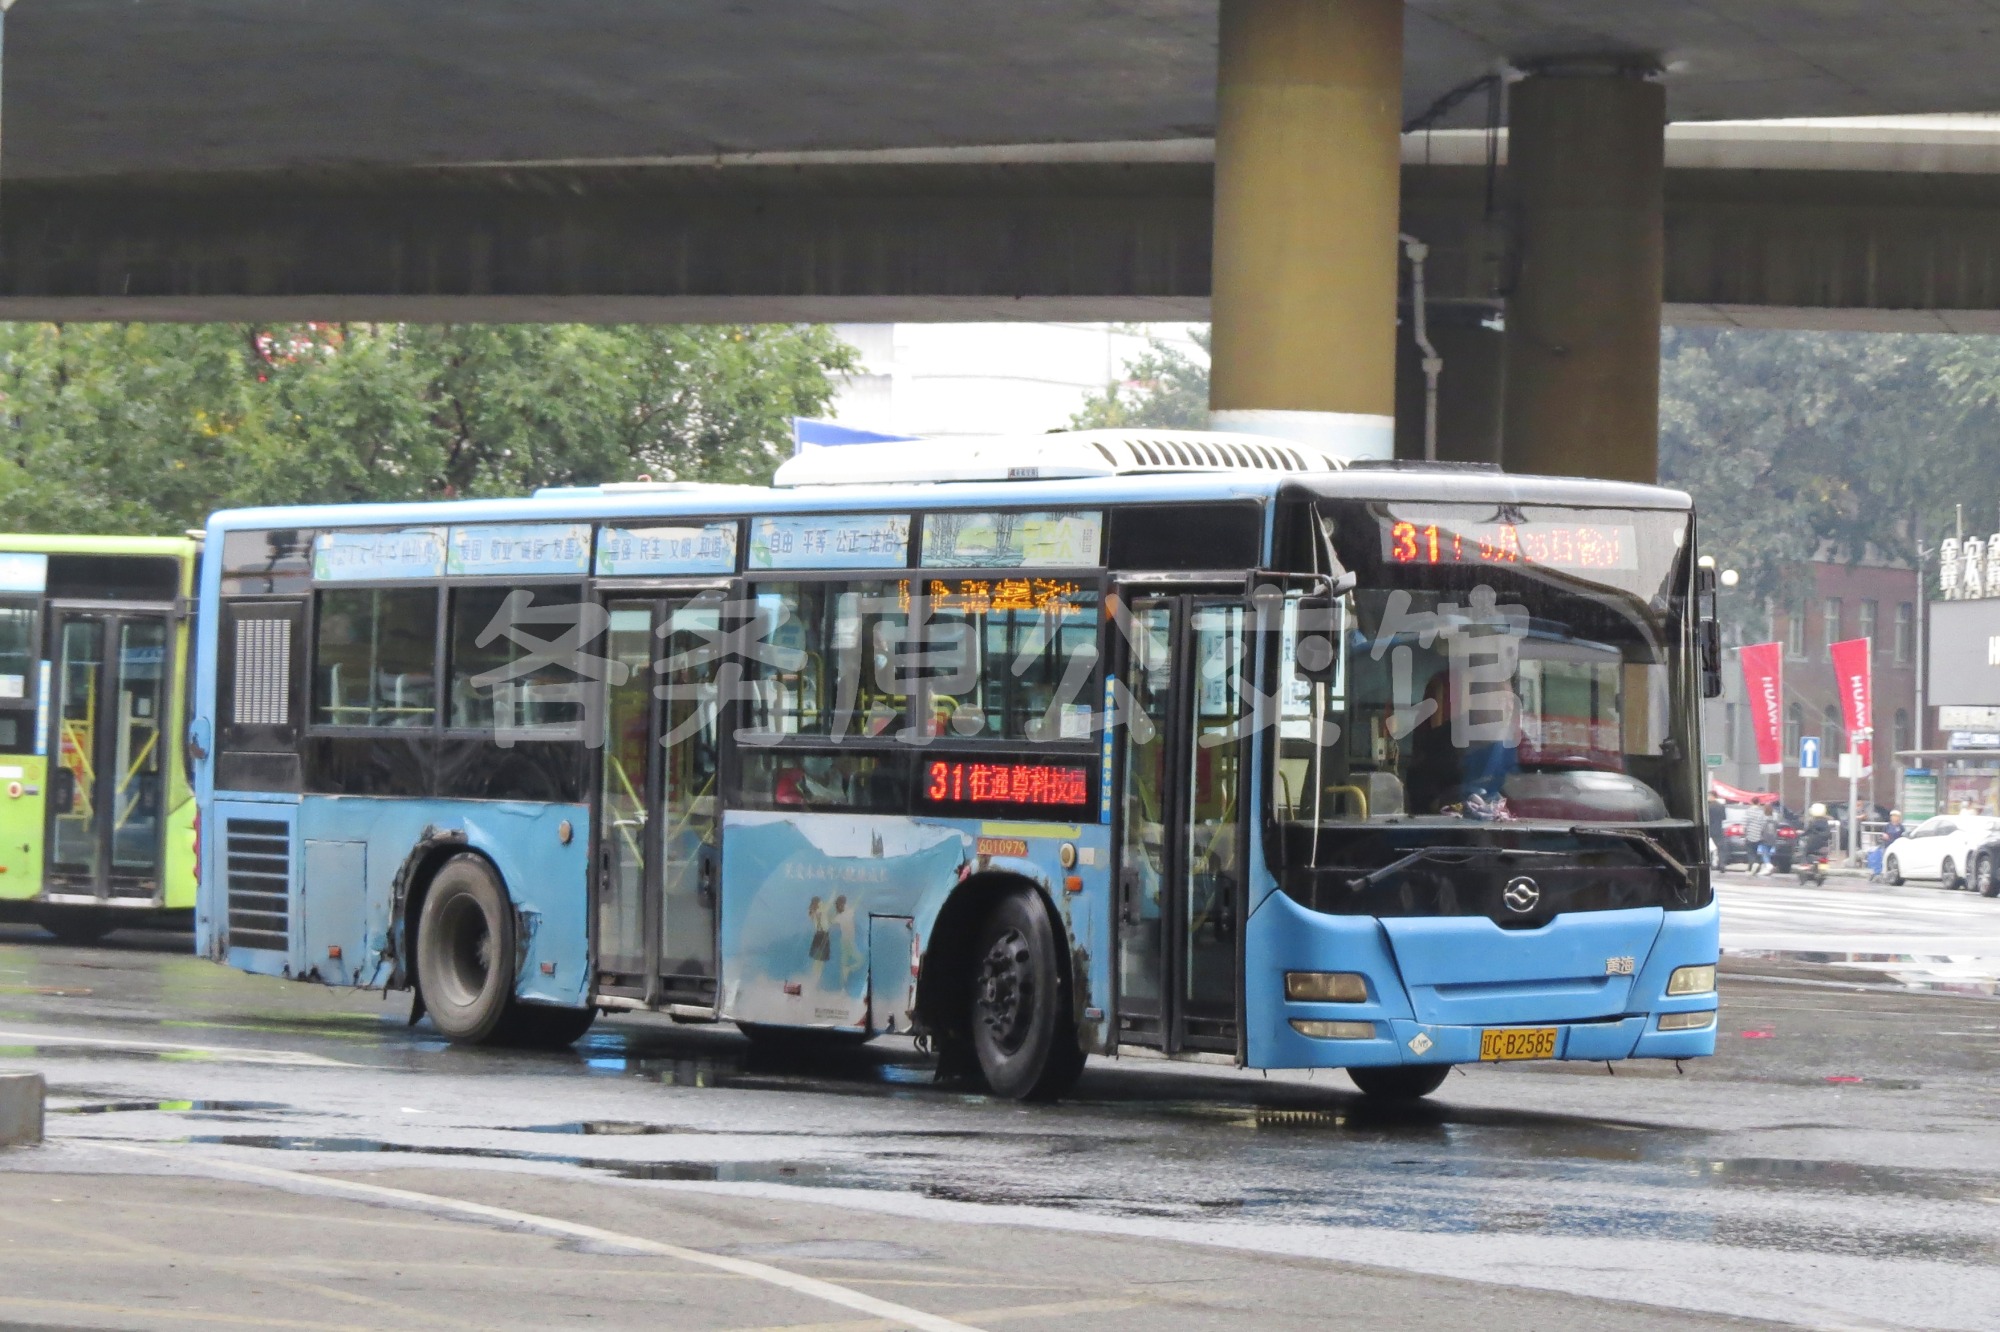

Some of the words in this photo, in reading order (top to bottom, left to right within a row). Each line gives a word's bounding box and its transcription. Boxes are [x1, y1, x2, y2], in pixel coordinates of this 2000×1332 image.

[770, 531, 794, 554] 自由
[803, 531, 827, 554] 平等
[836, 530, 861, 553] 公正
[1392, 520, 1440, 564] 31
[1850, 675, 1867, 733] HUAW
[930, 761, 963, 801] 31
[978, 839, 1026, 855] 6010979
[1605, 956, 1635, 975] 黄海
